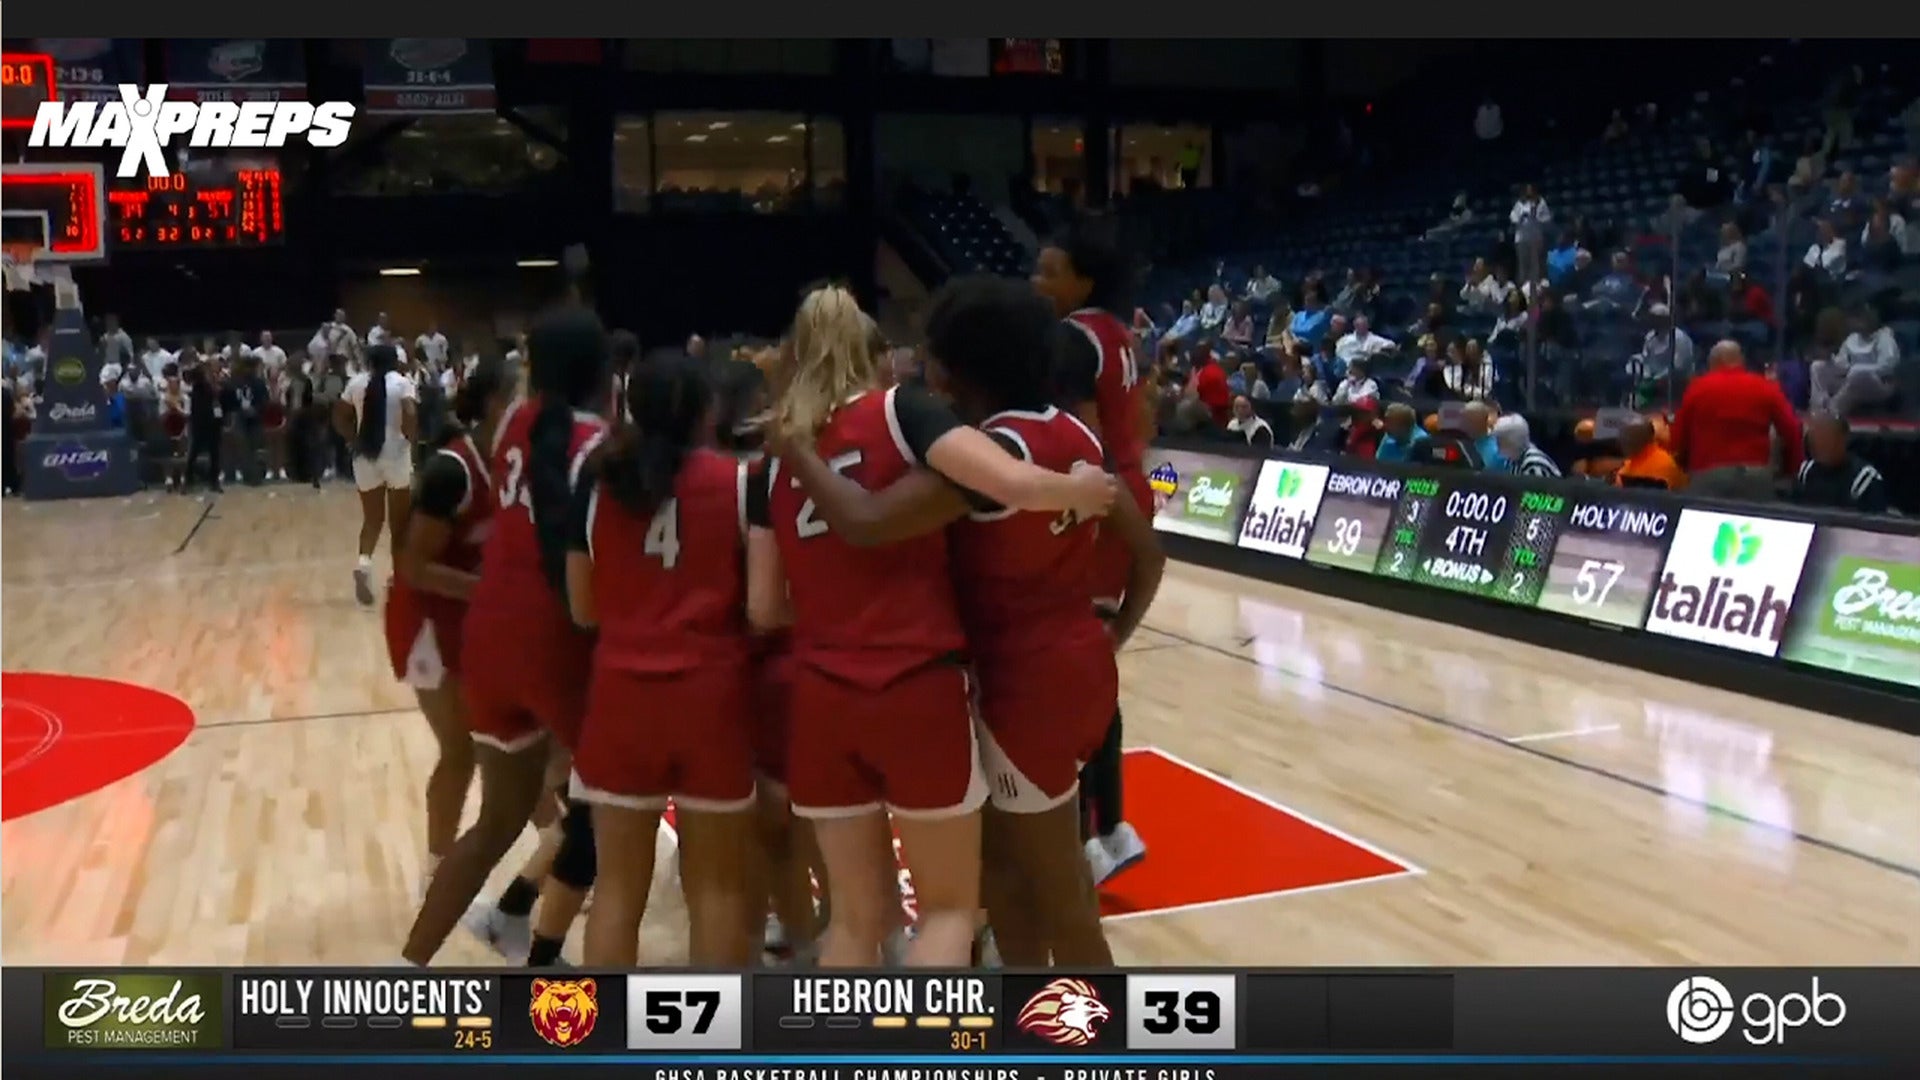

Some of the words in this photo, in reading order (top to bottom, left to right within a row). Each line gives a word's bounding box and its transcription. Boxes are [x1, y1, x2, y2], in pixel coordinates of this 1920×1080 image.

[43, 450, 108, 467] GHSA
[1371, 480, 1401, 500] CHR
[1407, 500, 1420, 523] 3
[1445, 491, 1507, 524] 0:00.0
[1570, 503, 1616, 531] HOLY
[1619, 511, 1668, 537] INNC
[643, 497, 680, 569] 4
[1243, 503, 1314, 548] taliah
[1327, 517, 1362, 556] 39
[1445, 525, 1488, 557] 4TH
[1526, 516, 1541, 541] 5
[1390, 551, 1404, 573] 2
[1430, 557, 1482, 584] BONUS
[1509, 571, 1525, 595] 2
[1572, 559, 1625, 608] 57
[1655, 571, 1789, 642] taliah
